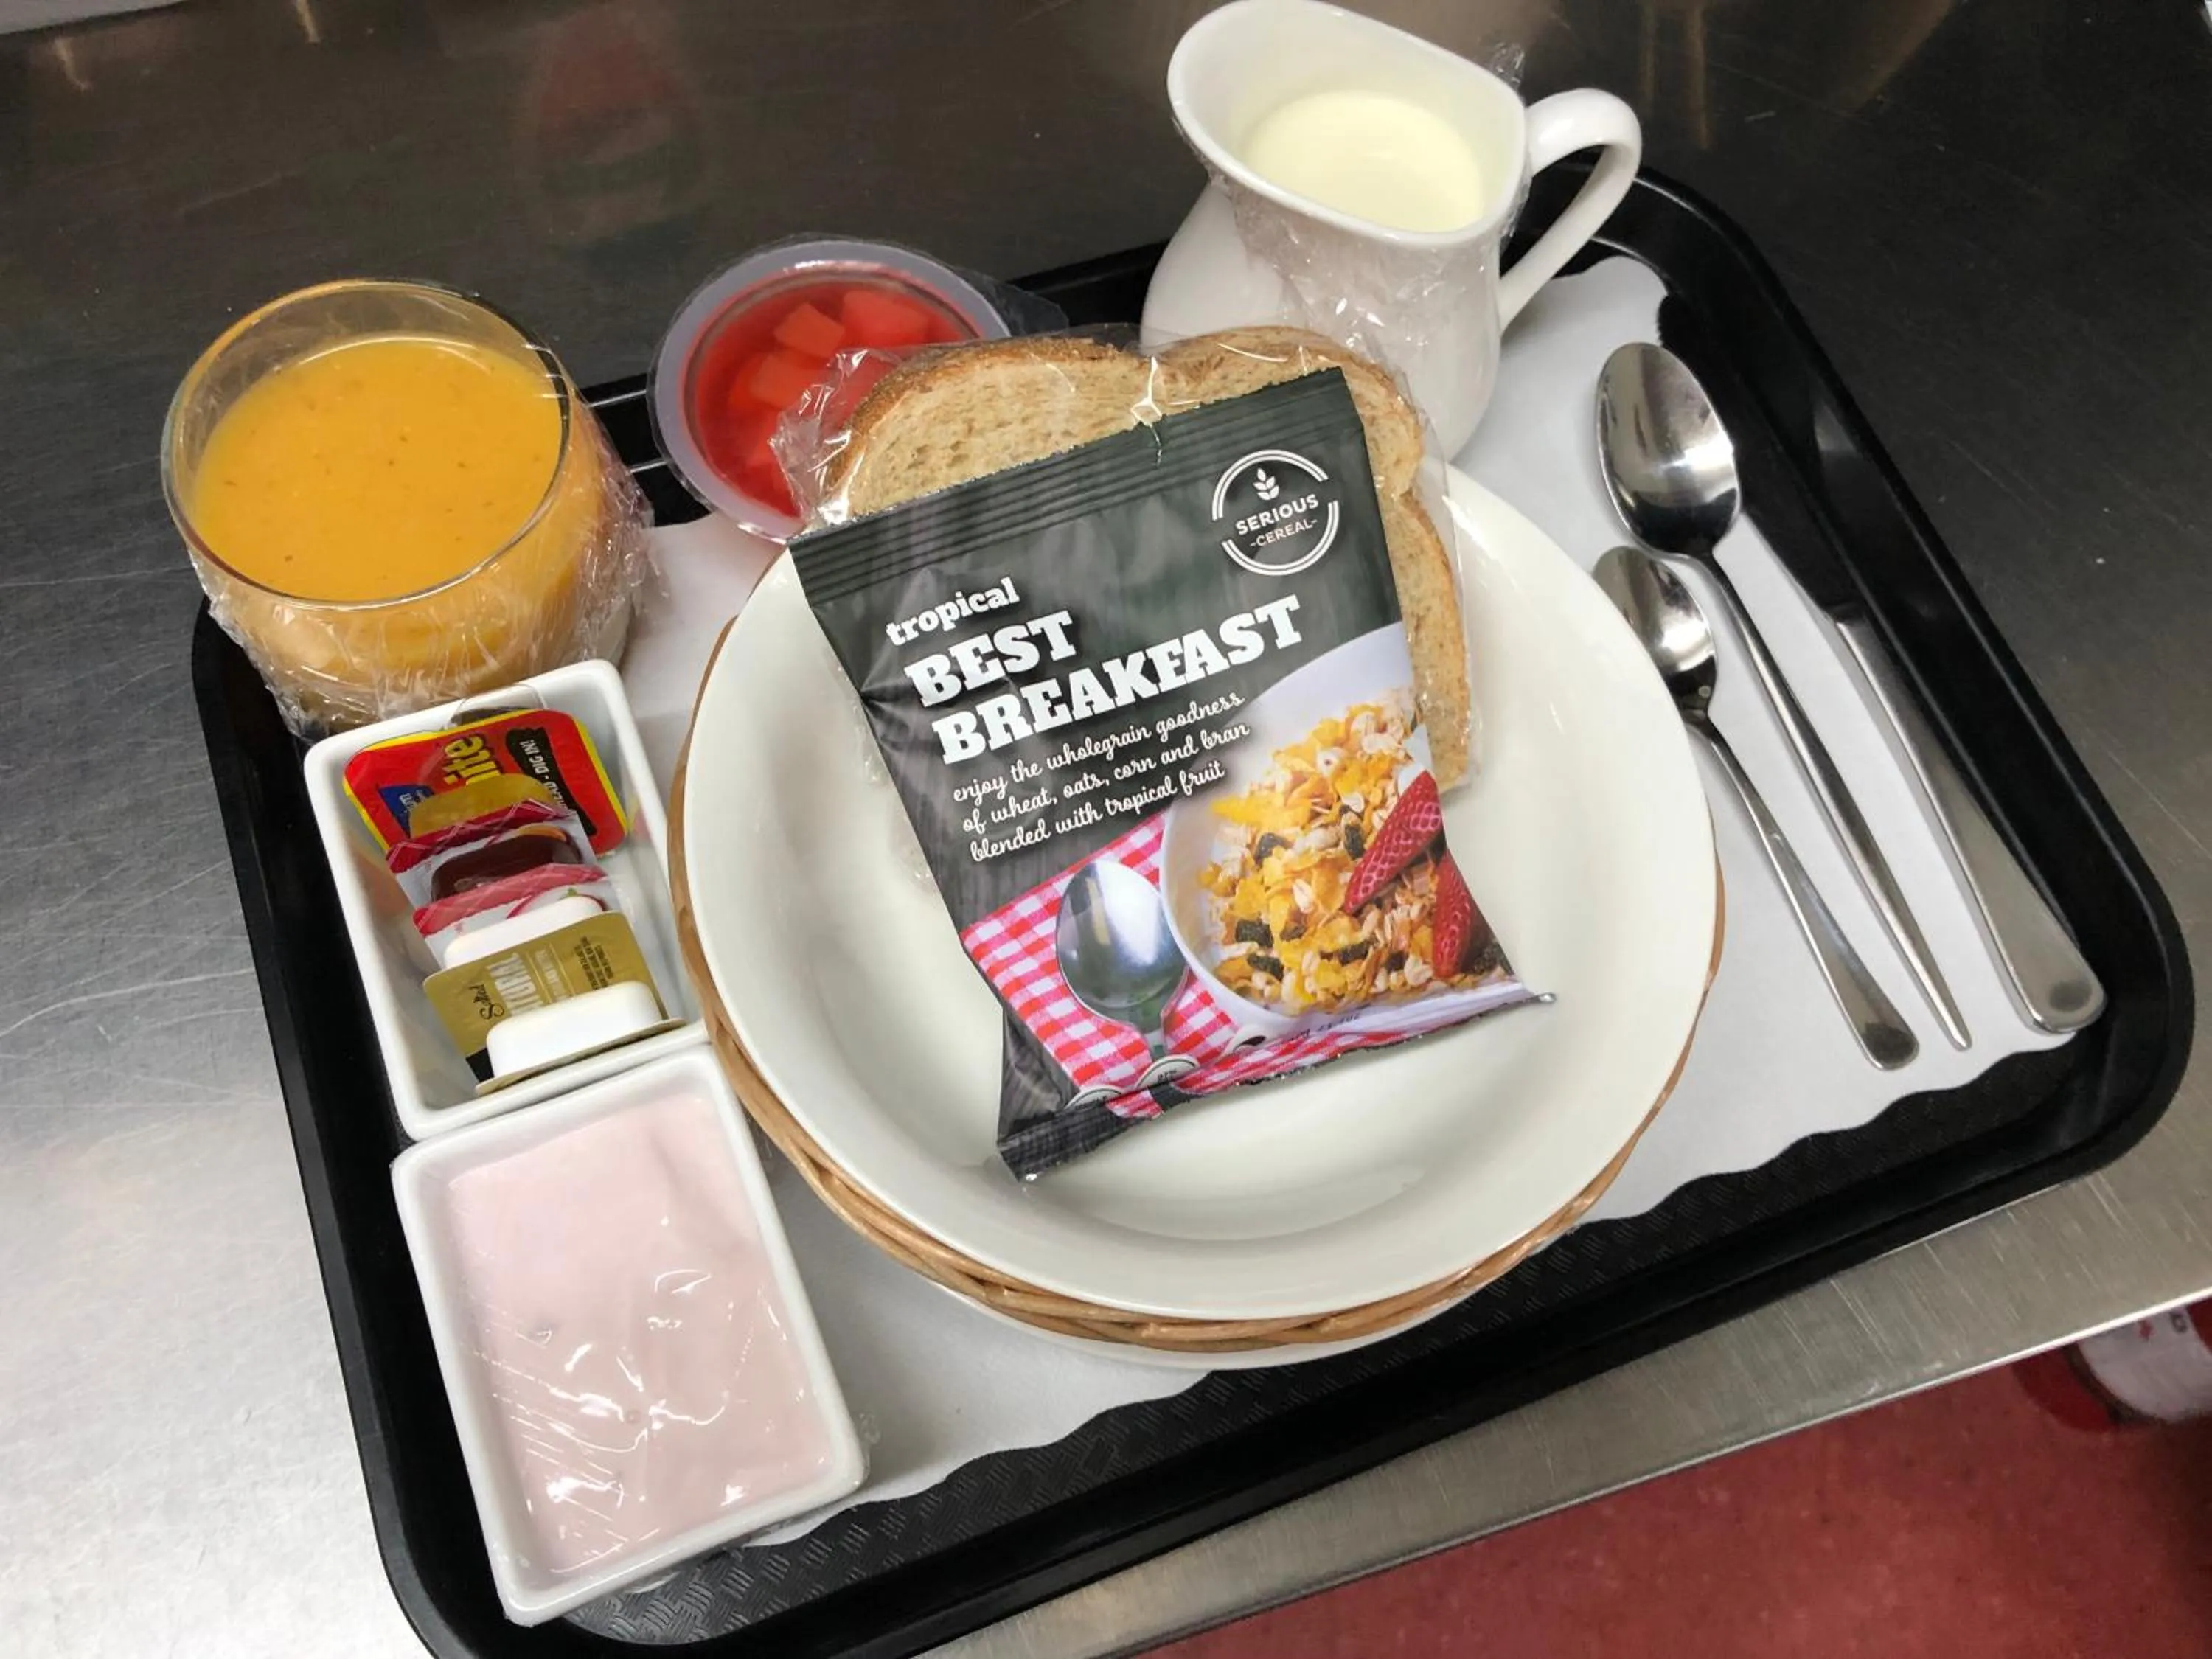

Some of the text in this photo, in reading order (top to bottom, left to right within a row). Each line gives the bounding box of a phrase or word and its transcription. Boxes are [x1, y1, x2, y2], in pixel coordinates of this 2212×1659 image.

[1235, 493, 1319, 535] SERIOUS
[886, 577, 1020, 647] tropical
[904, 611, 1077, 708] BEST
[931, 594, 1303, 765] BREAKFAST
[529, 754, 549, 774] DIG
[953, 691, 1246, 806] enjoy the wholegrain goodness
[962, 723, 1251, 836] of wheat, oats, corn and bran
[970, 759, 1226, 863] blended with tropical fruit
